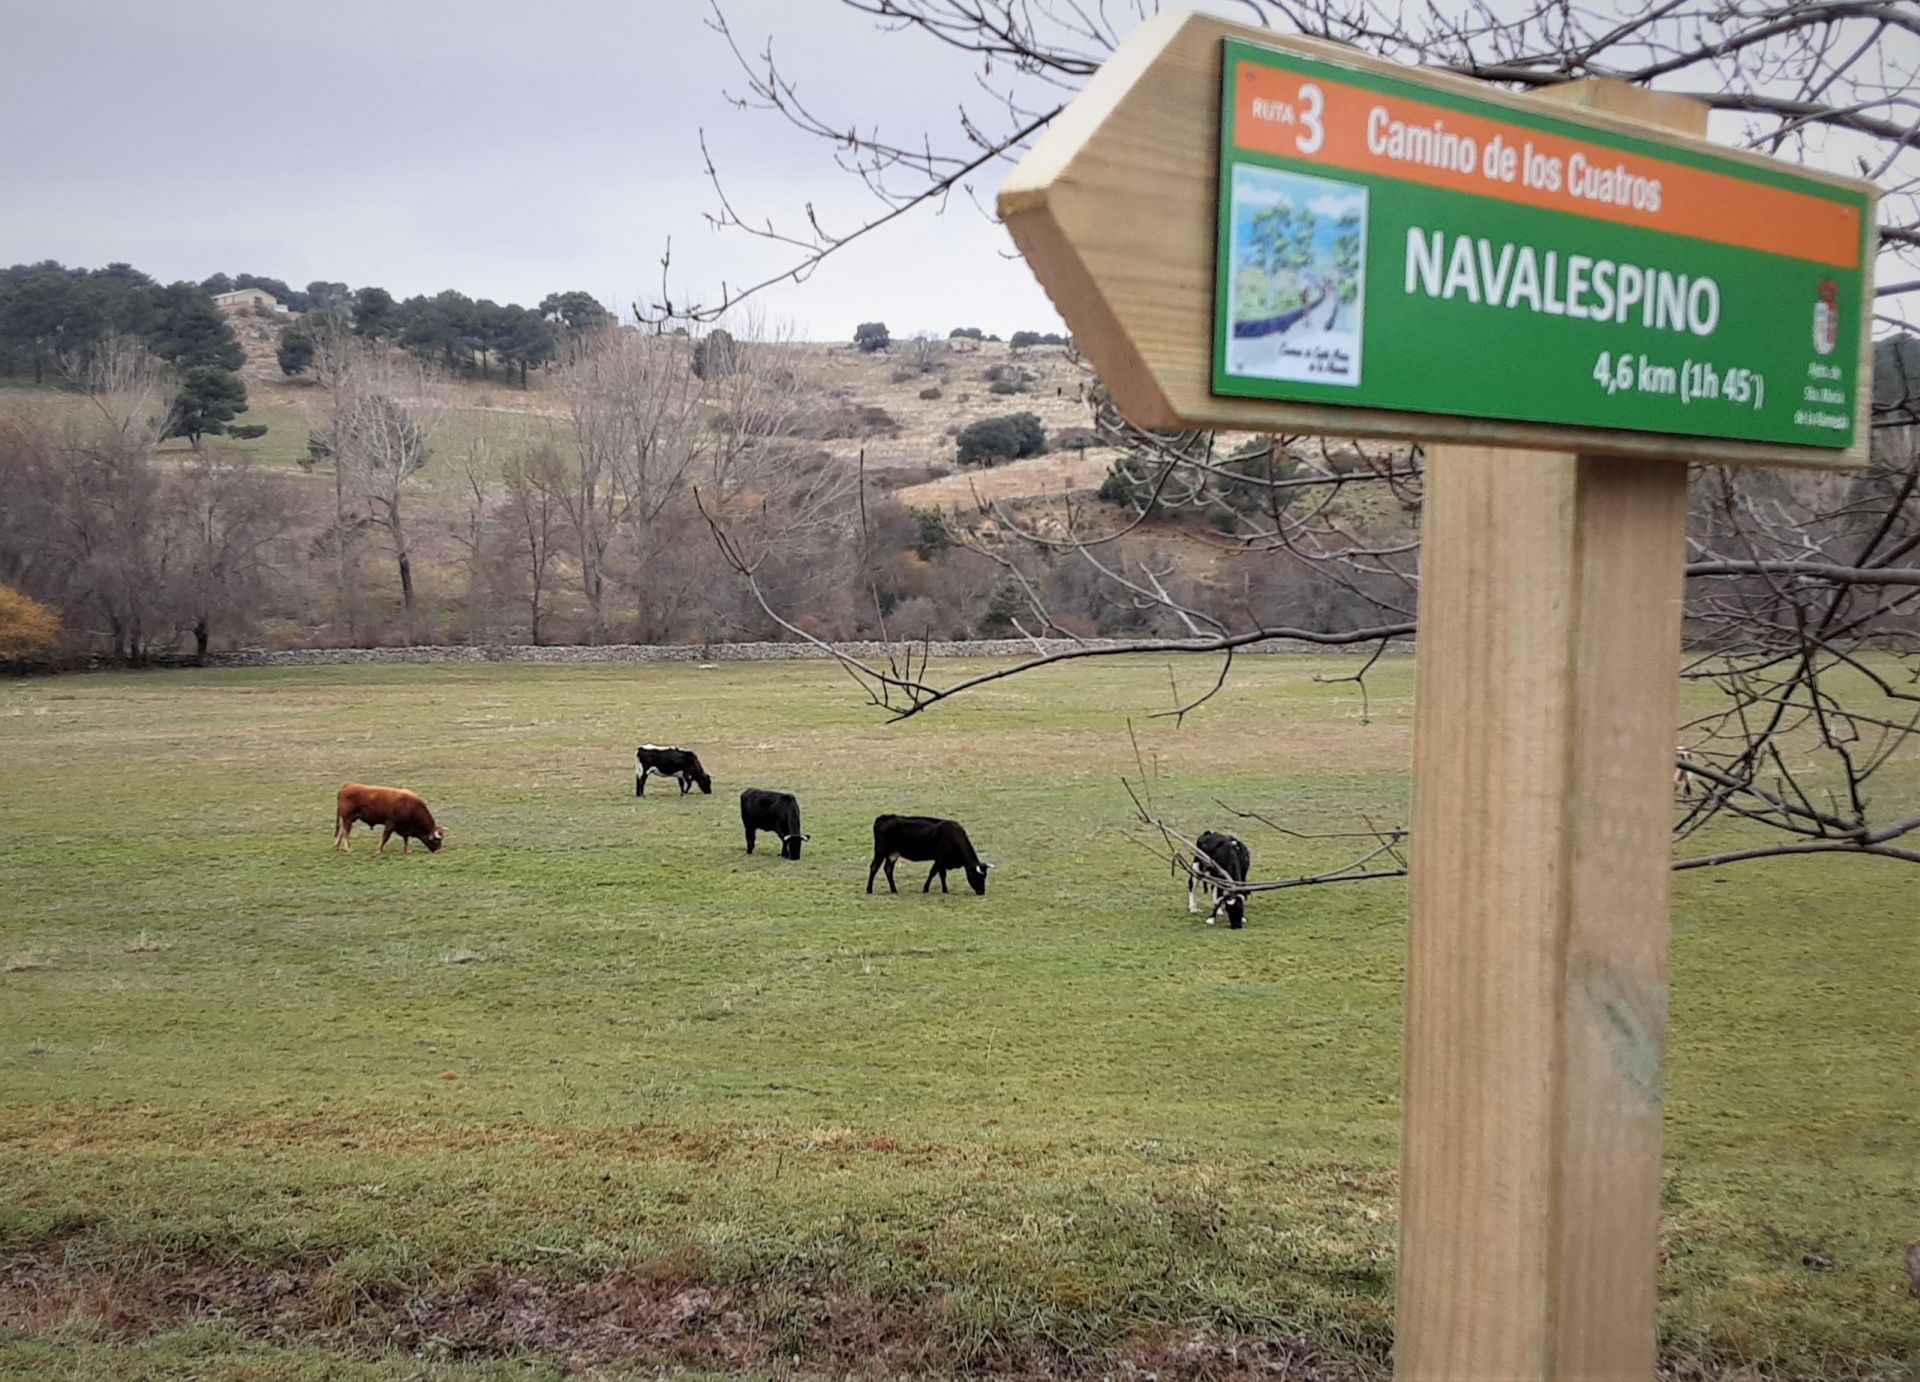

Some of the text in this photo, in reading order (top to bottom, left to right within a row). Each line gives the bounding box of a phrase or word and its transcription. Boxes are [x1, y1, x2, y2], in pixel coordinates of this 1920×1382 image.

[1252, 84, 1325, 154] RUTA 3
[1367, 106, 1661, 211] Camino de los Cuatros
[1405, 227, 1721, 336] NAVALESPINO
[1593, 351, 1633, 394] 4,6
[1638, 355, 1676, 393] km
[1680, 359, 1719, 405] (1h
